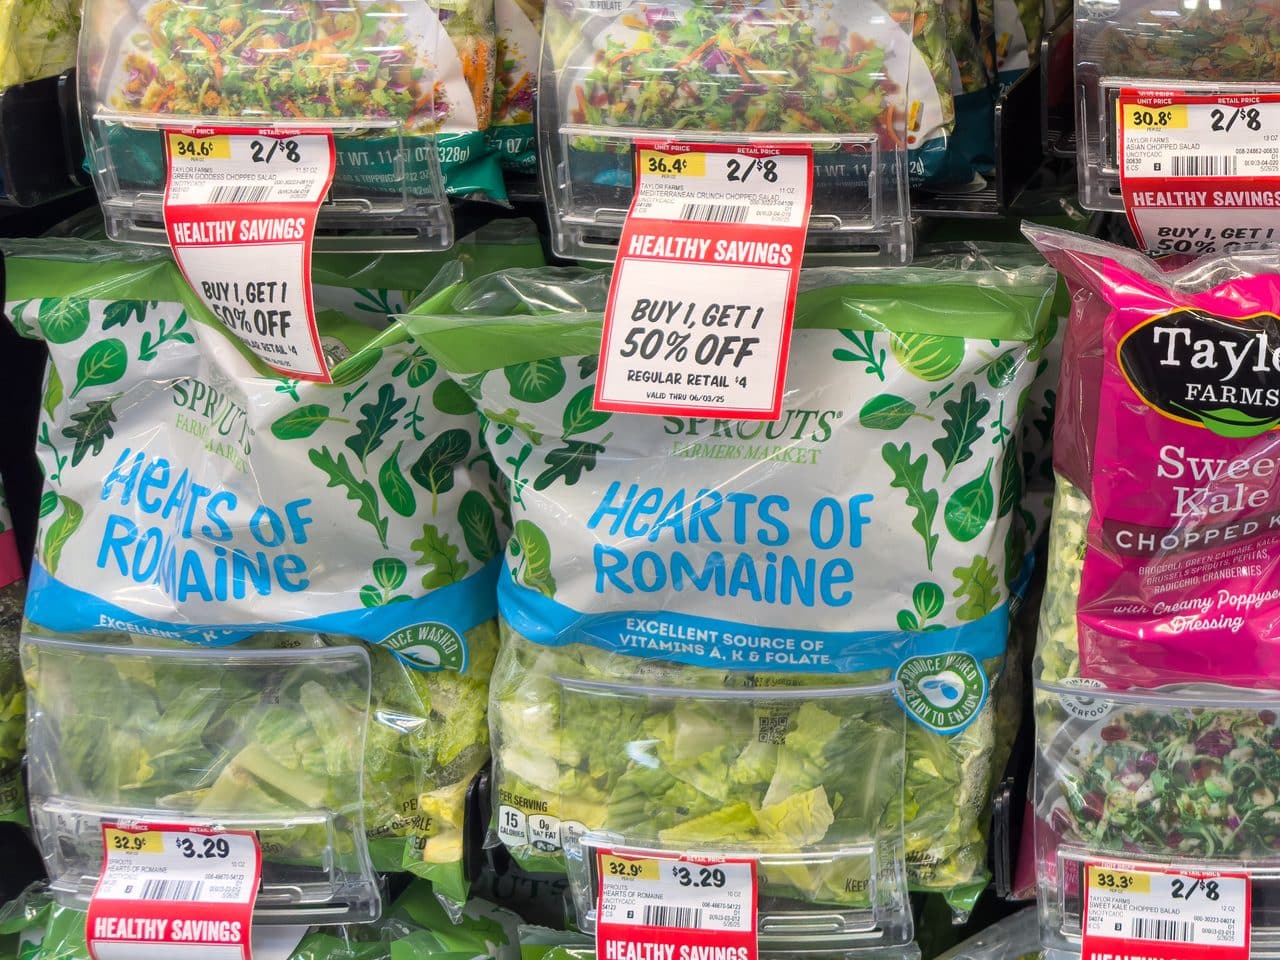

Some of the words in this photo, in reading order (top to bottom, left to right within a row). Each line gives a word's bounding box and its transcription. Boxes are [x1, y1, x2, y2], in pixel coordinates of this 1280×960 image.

[1133, 111, 1172, 126] 30.8¢
[1211, 109, 1261, 132] 2/$8
[178, 141, 213, 156] 34.6¢
[250, 140, 300, 163] 2/$8
[648, 158, 687, 173] 36.4¢
[726, 159, 779, 183] 2/$8
[1133, 192, 1207, 206] HEALTHY
[173, 222, 235, 242] HEALTHY
[239, 218, 305, 241] SAVINGS
[629, 235, 710, 259] HEALTHY
[715, 241, 792, 265] SAVINGS
[631, 298, 682, 323] BUY
[683, 302, 696, 328] 1,
[702, 304, 751, 327] GET
[751, 307, 764, 328] 1
[620, 328, 692, 363] 50%
[695, 335, 759, 368] OFF
[1185, 384, 1280, 406] FARMS
[1170, 486, 1269, 518] Kale
[249, 498, 313, 548] OF
[810, 493, 874, 550] OF
[1116, 521, 1259, 551] CHOPPED
[625, 618, 718, 643] EXCELLENT
[723, 633, 797, 649] SOURCE
[801, 639, 824, 651] OF
[112, 835, 146, 851] 32.9¢
[175, 838, 230, 858] $3.29
[609, 862, 642, 877] 32.9¢
[672, 866, 726, 888] $3.29
[1097, 873, 1133, 888] 33.3¢
[1171, 879, 1220, 900] 2/$8
[94, 916, 167, 941] HEALTHY
[172, 918, 241, 943] SAVINGS
